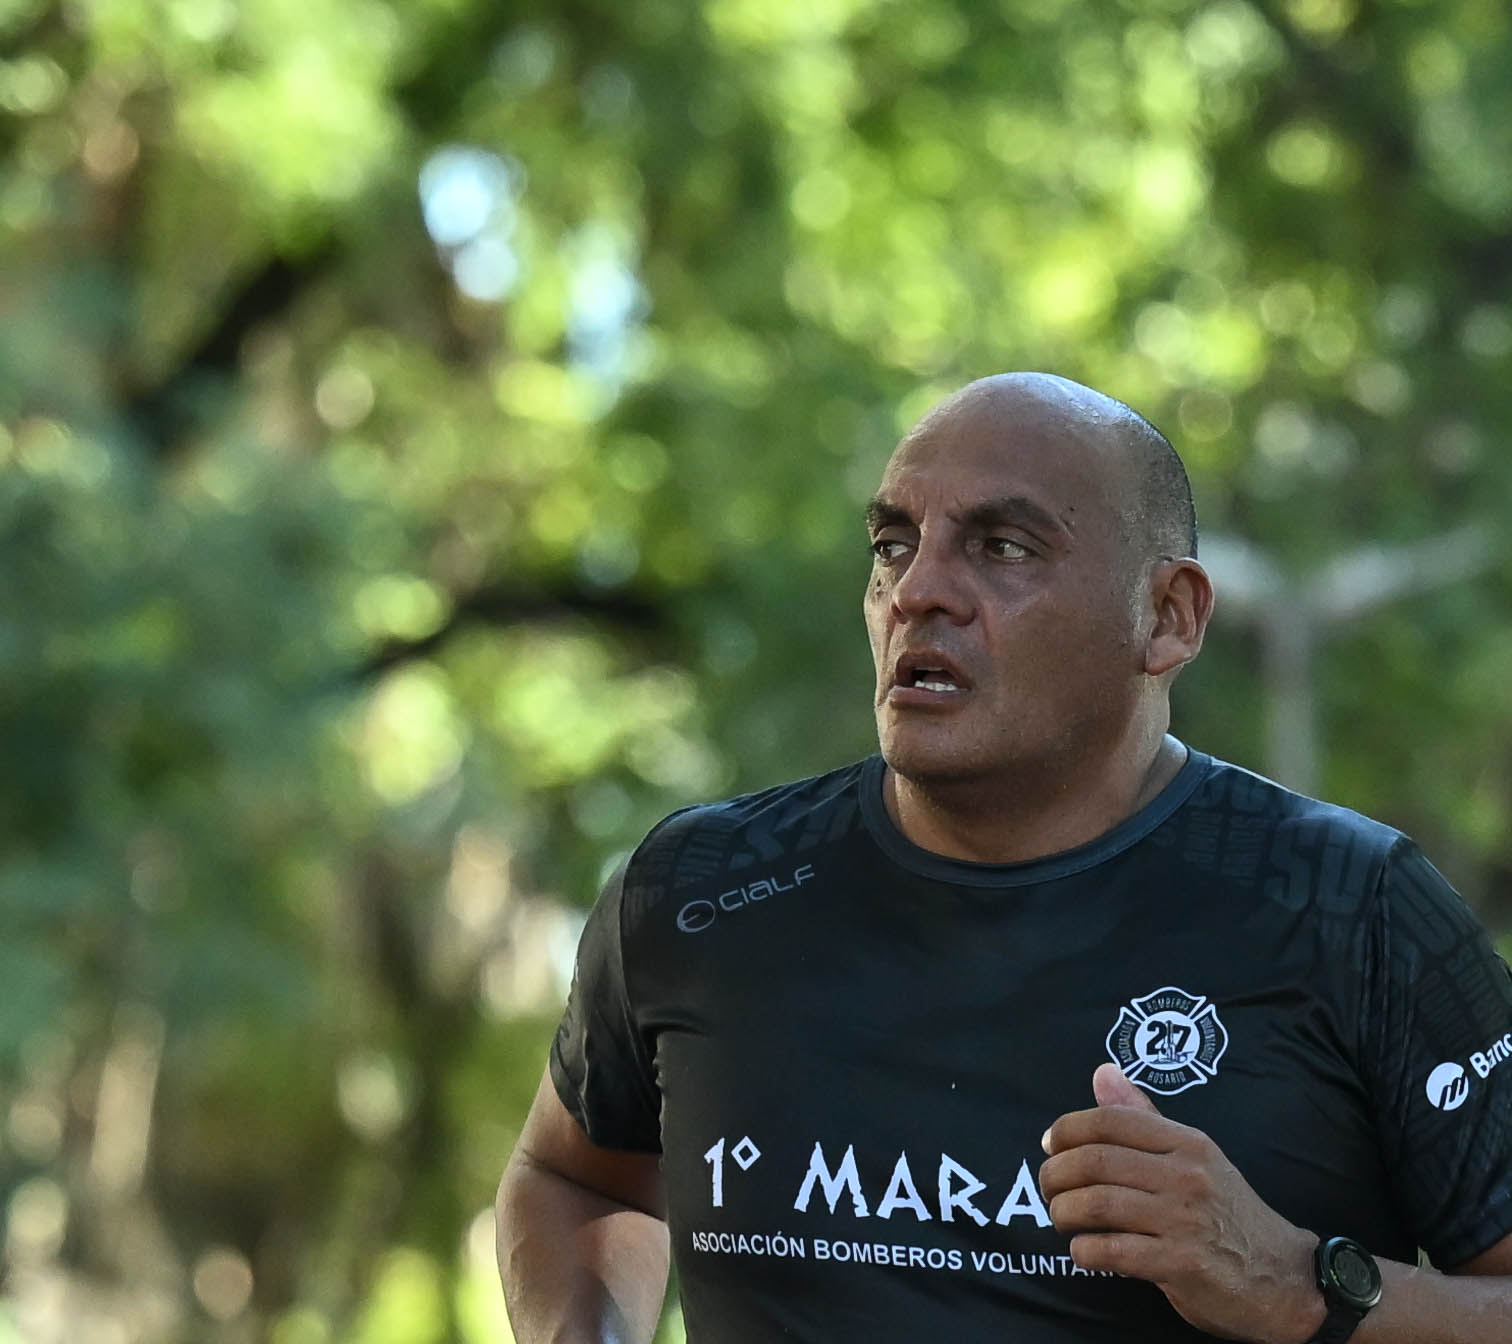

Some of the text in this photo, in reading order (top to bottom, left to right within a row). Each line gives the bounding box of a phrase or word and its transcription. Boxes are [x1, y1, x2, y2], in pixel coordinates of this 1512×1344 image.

[1146, 1020, 1192, 1056] 27
[1147, 1070, 1187, 1085] ROSARIO
[793, 1141, 1054, 1228] MARA
[691, 1230, 806, 1259] ASOCIACIÓN
[814, 1239, 963, 1271] BOMBEROS
